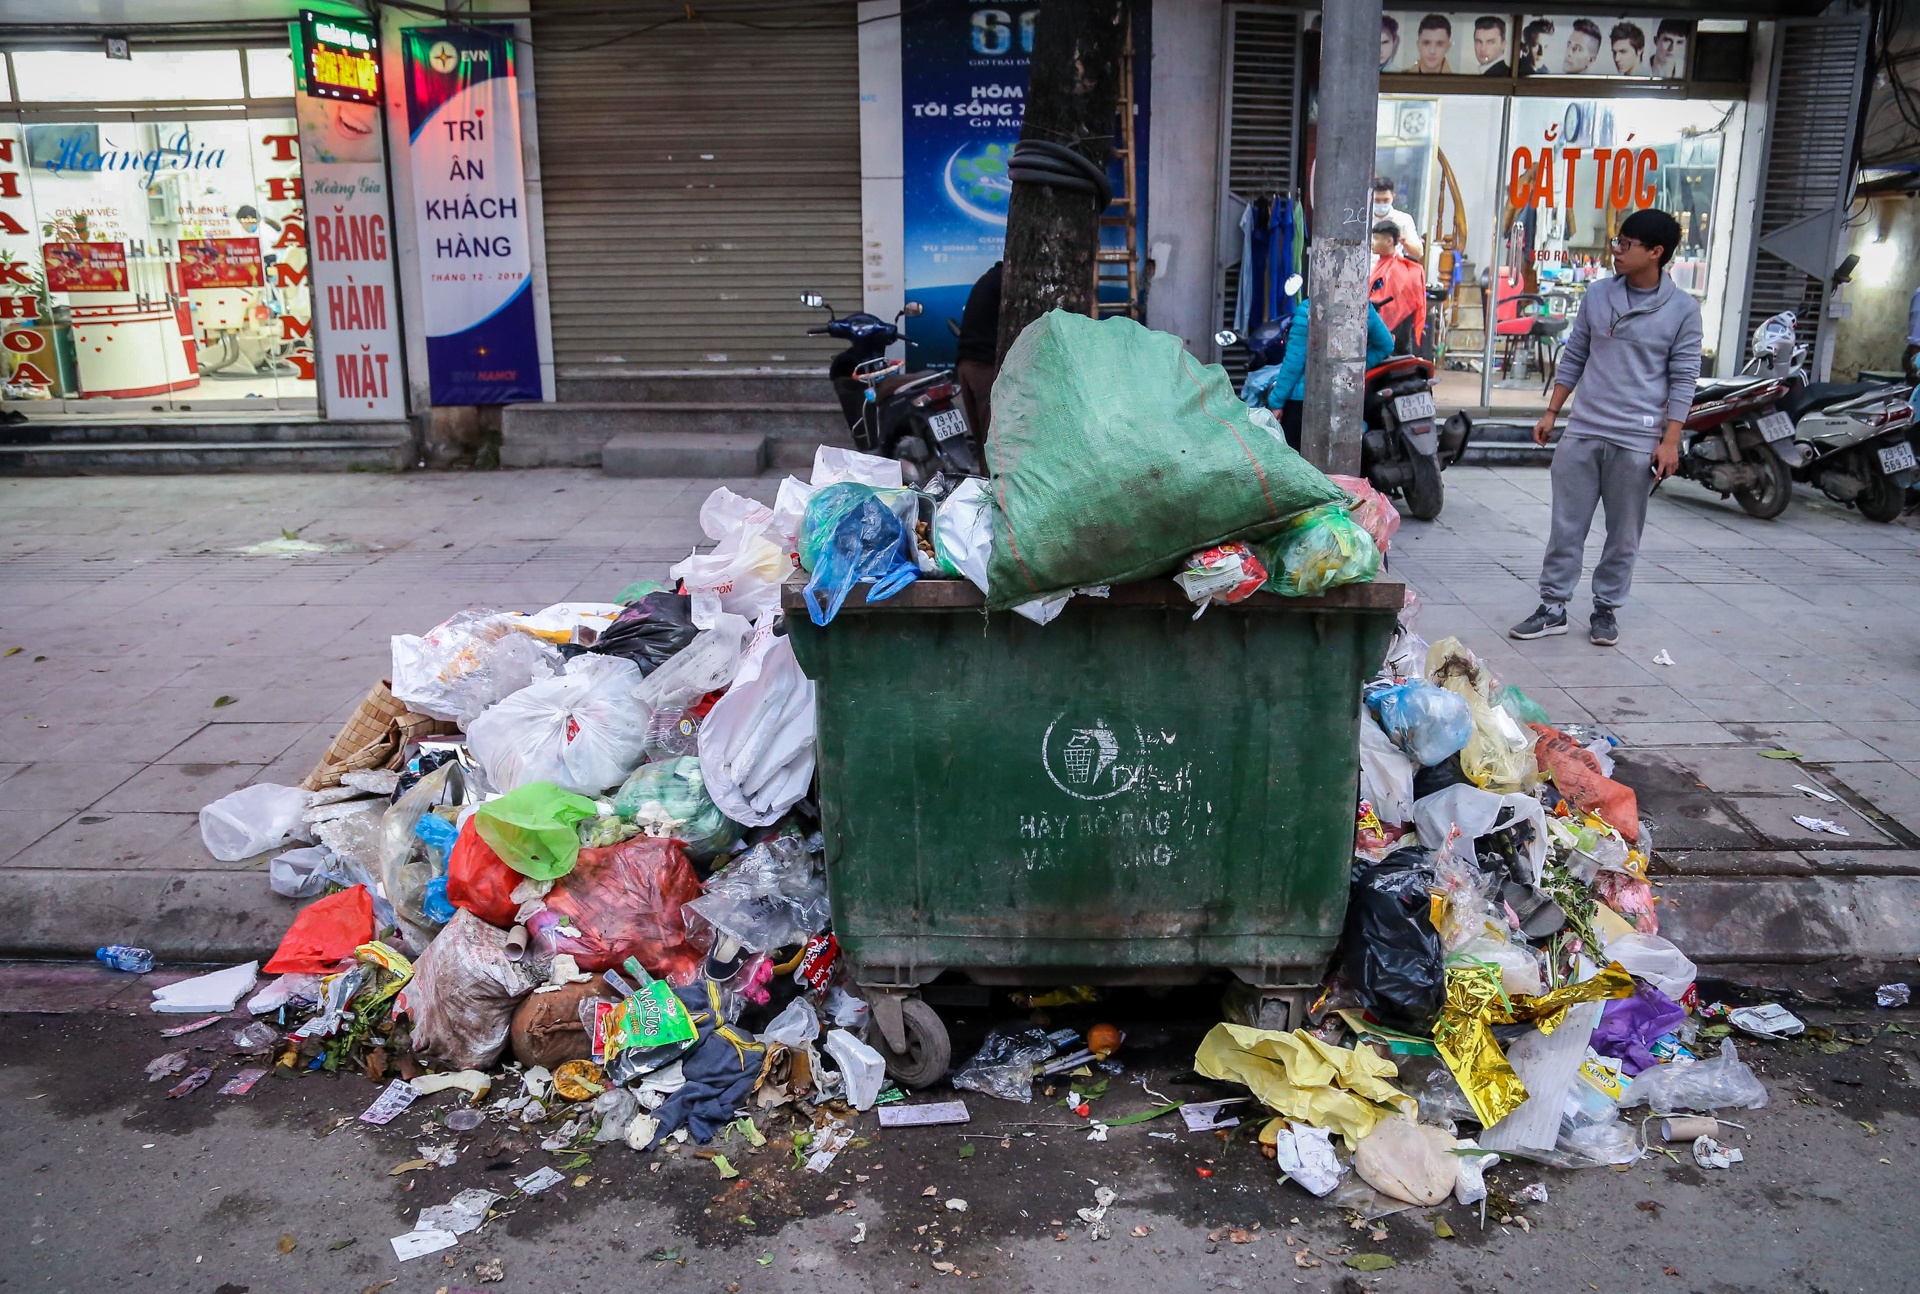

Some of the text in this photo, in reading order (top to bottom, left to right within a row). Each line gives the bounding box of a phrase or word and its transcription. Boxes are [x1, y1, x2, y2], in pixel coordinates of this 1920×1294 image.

[461, 49, 489, 62] EVN
[971, 83, 1023, 98] HÔM
[912, 101, 947, 116] TÔI
[953, 99, 1013, 116] SỐNG
[969, 118, 1022, 128] Go Mo
[46, 130, 227, 190] Hoàng Gia
[449, 155, 484, 181] ÂN
[1508, 123, 1658, 210] CẮT TÓC
[426, 193, 517, 221] KHÁCH
[315, 205, 387, 262] RĂNG
[436, 232, 511, 258] HÀNG
[1554, 250, 1568, 261] RA
[473, 273, 483, 281] 12
[498, 272, 523, 280] 2018
[327, 274, 387, 331] HÀM
[335, 344, 389, 409] MẶT
[1585, 1065, 1617, 1089] Custas
